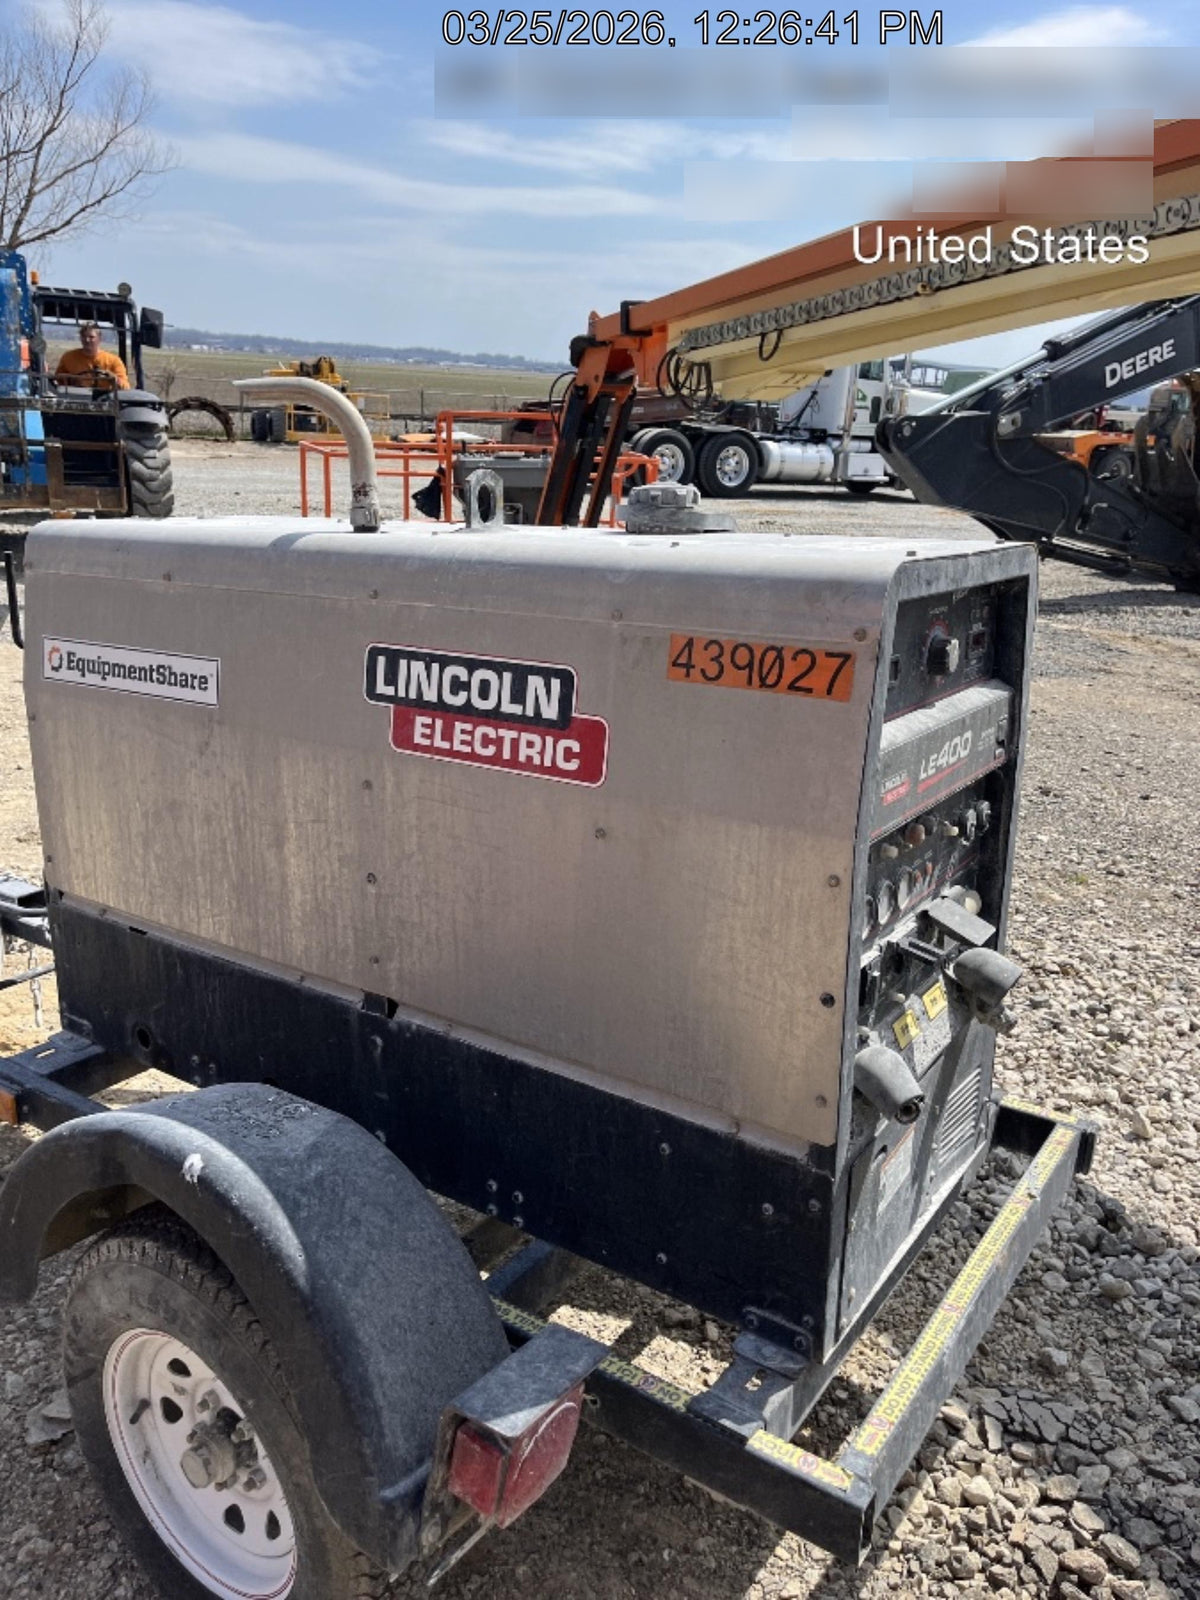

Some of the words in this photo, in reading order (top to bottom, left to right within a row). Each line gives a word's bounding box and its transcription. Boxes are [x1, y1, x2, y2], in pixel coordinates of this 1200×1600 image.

[1105, 338, 1176, 388] DEERE
[66, 651, 209, 691] EquipmentShare
[374, 655, 561, 720] LINCOLN
[671, 637, 852, 695] 439027
[412, 715, 581, 772] ELECTRIC
[919, 730, 972, 780] LE400
[657, 1387, 682, 1401] NO
[883, 1397, 900, 1416] DO
[898, 1376, 915, 1398] NOT
[911, 1340, 936, 1375] STAND
